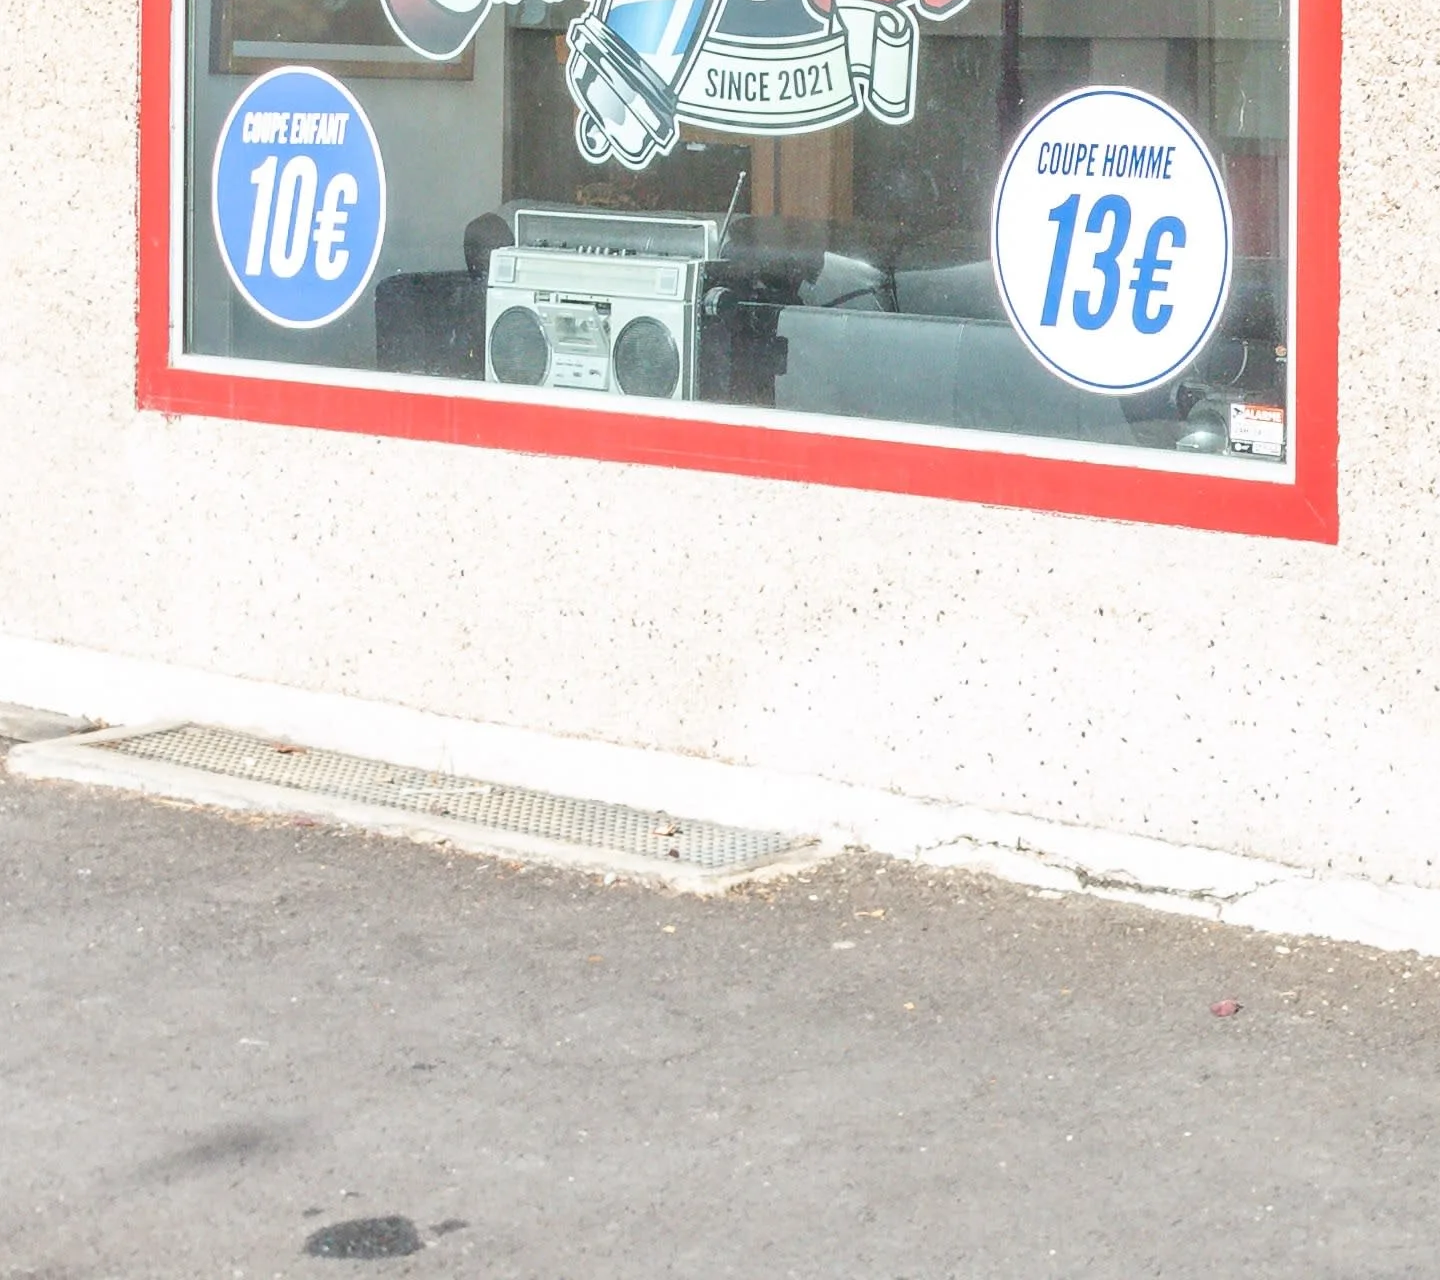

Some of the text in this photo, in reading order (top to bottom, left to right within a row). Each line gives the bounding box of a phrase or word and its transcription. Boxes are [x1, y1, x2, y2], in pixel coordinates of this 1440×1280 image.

[704, 61, 834, 101] SINCE 2021
[243, 111, 350, 145] COUPE ENFANT
[1037, 141, 1177, 181] COUPE HOMME
[244, 155, 359, 281] 10€
[1040, 193, 1188, 335] 13€
